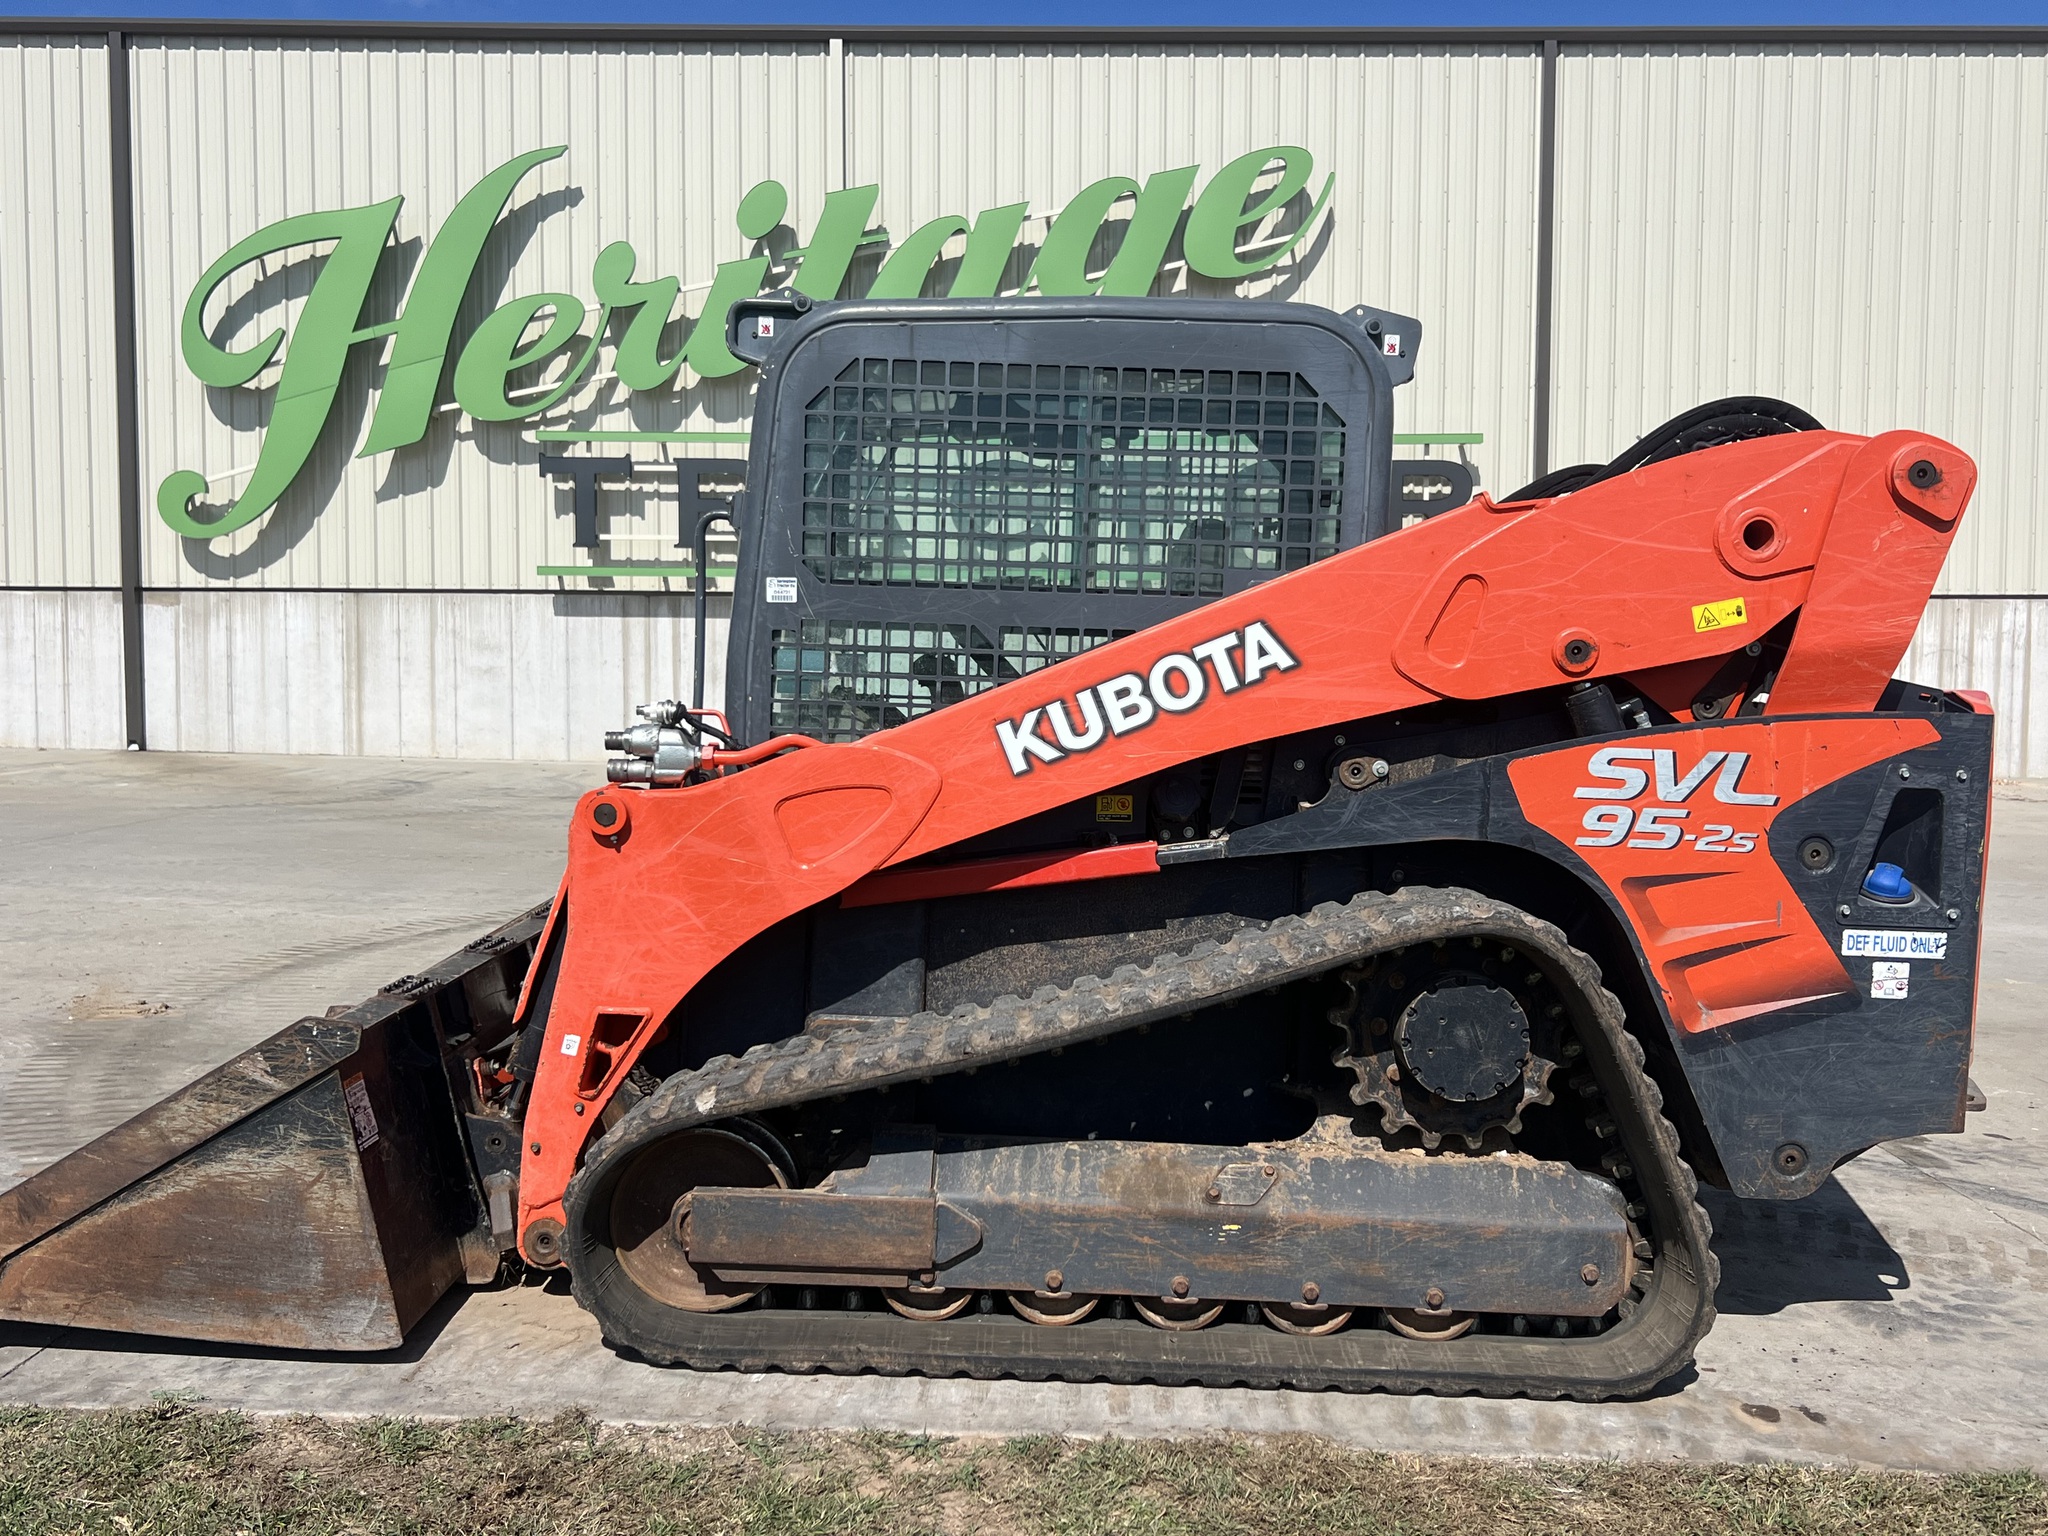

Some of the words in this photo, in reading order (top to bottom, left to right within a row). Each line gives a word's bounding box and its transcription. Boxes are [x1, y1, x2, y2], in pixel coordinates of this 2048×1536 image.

[157, 145, 1336, 539] Heritage
[995, 621, 1298, 776] KUBOTA
[1573, 748, 1780, 806] SVL
[1846, 934, 1871, 951] DEF
[1873, 935, 1907, 953] FLUID
[1910, 936, 1943, 954] ONLY
